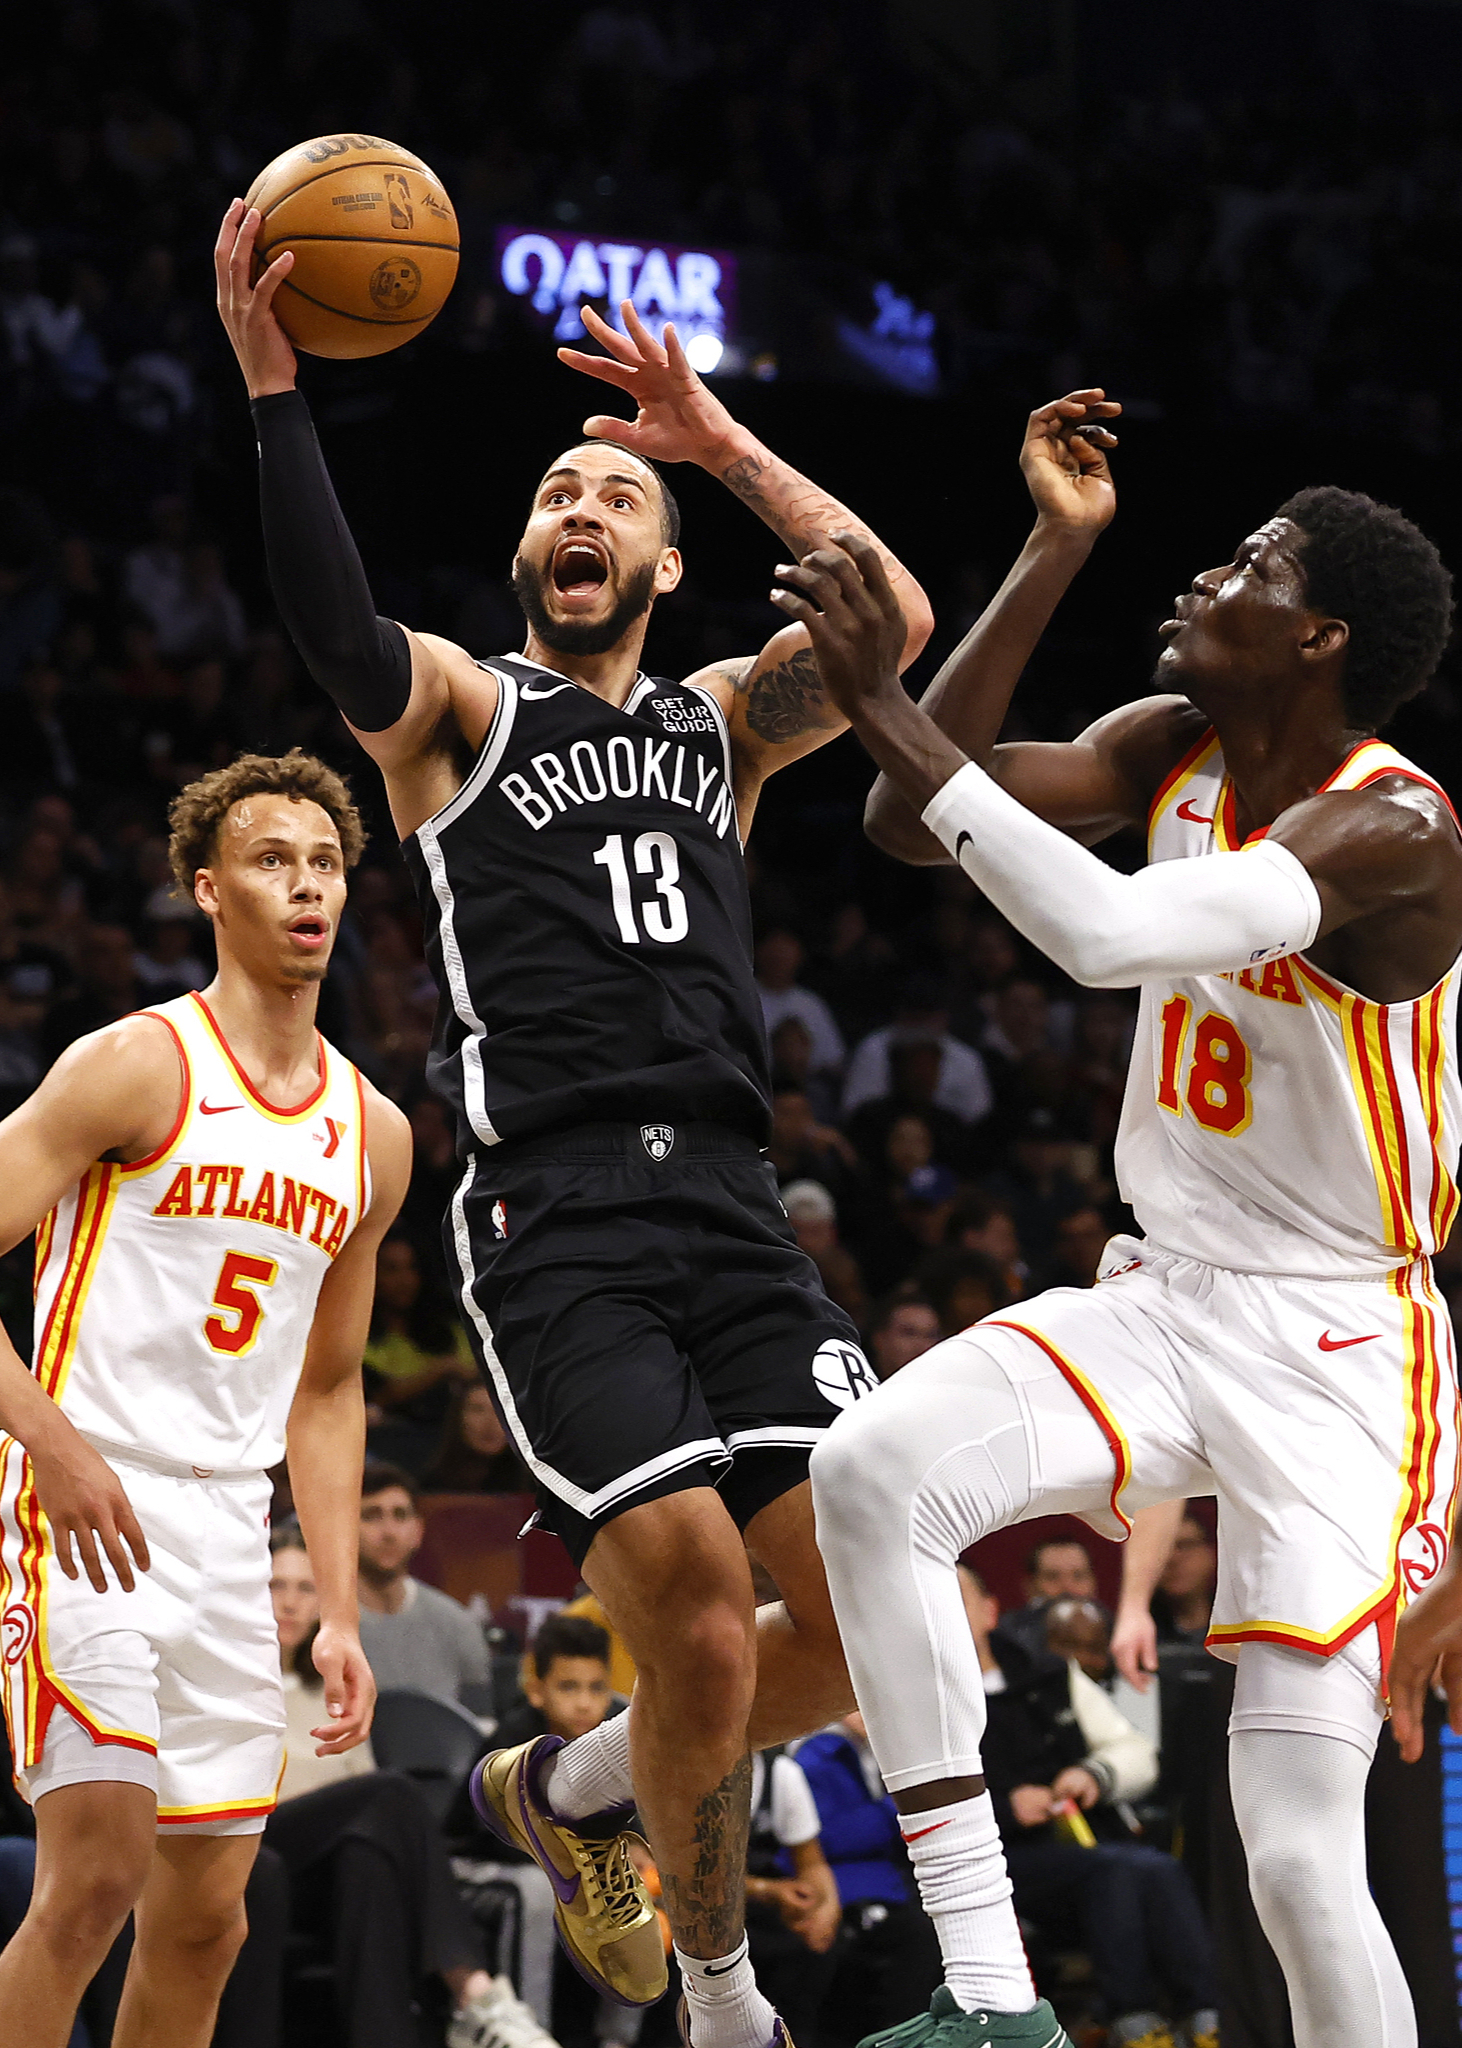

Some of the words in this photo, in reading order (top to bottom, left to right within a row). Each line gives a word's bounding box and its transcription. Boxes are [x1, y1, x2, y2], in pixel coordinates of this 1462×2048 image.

[502, 234, 724, 317] QATAR
[651, 697, 684, 709] GET
[656, 706, 710, 720] YOUR
[662, 719, 717, 732] GUIDE
[499, 737, 732, 839] BROOKLYN
[593, 832, 689, 943] 13
[1156, 992, 1253, 1138] 18
[644, 1127, 671, 1141] NETS
[152, 1164, 349, 1262] ATLANTA
[202, 1249, 279, 1358] 5
